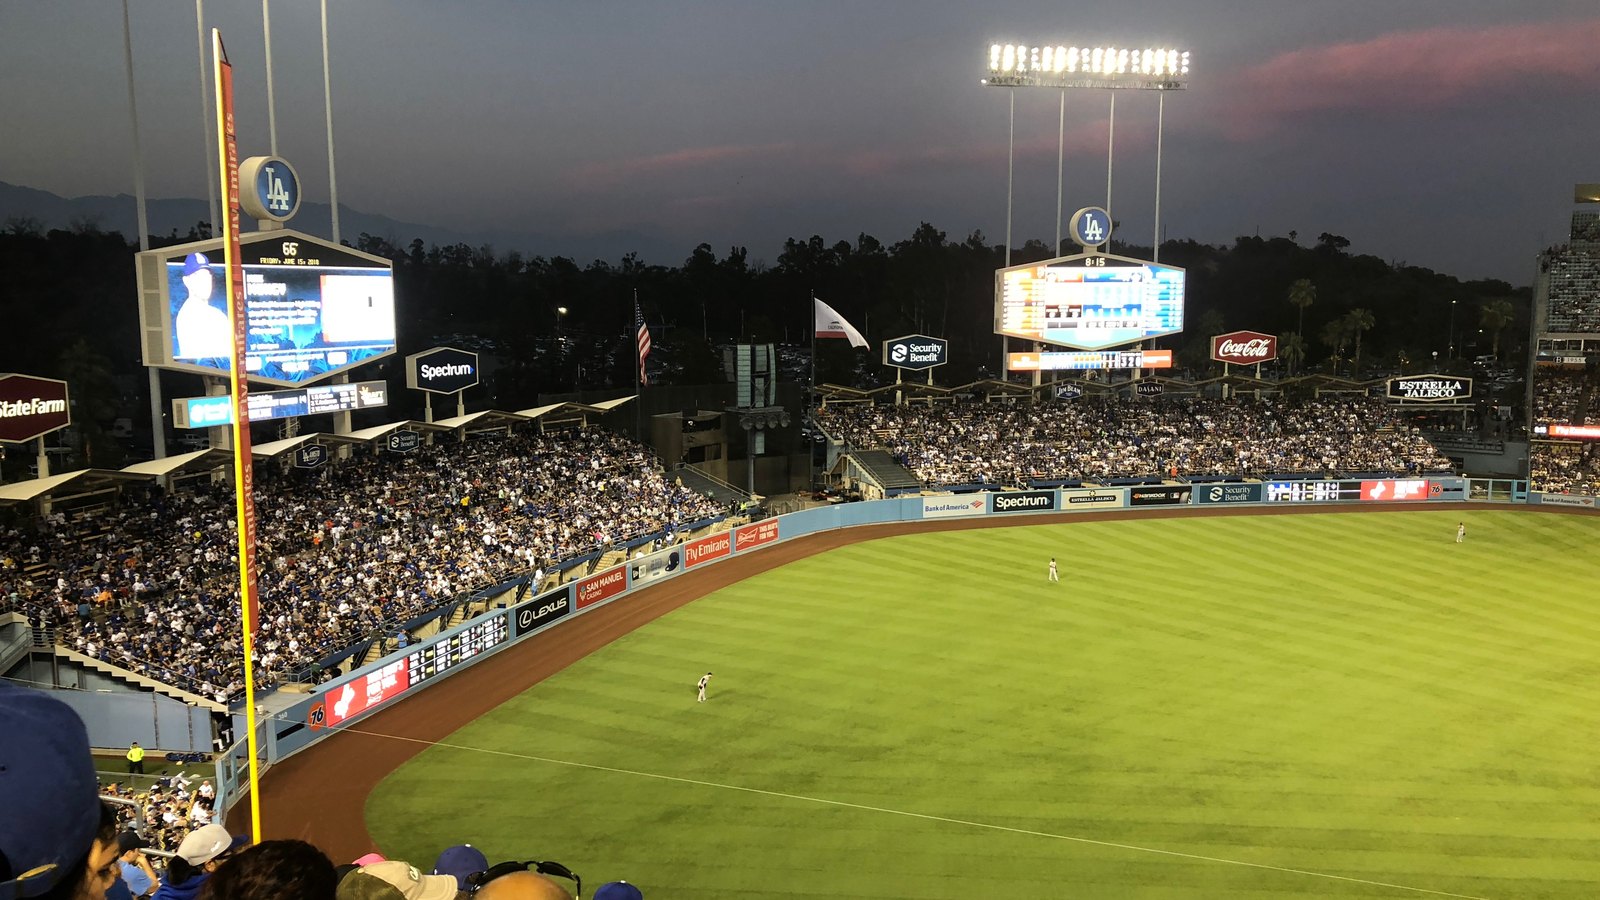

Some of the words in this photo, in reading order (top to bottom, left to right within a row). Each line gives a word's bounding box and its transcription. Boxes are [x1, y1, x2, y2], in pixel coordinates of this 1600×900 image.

[265, 167, 289, 211] LA
[1085, 213, 1103, 241] LA
[1085, 258, 1106, 267] 8:15
[909, 343, 942, 354] Security
[1218, 338, 1272, 357] Coca-Cola
[909, 353, 938, 362] Benefit
[421, 363, 471, 381] Spectrum
[1057, 385, 1067, 396] JIM
[1067, 385, 1081, 395] BEAM
[1398, 380, 1462, 390] ESTRELLA
[1404, 389, 1455, 398] JALISCO
[1224, 486, 1251, 495] Security
[1224, 493, 1249, 501] Benefit
[244, 463, 256, 549] Emirates
[946, 503, 969, 512] America
[996, 495, 1048, 510] Spectrum
[685, 547, 698, 561] Fly
[698, 537, 730, 556] Emirates
[586, 582, 599, 593] SAN
[599, 571, 624, 588] MANUEL
[586, 589, 602, 600] CASINO
[532, 597, 567, 620] LEXUS
[311, 705, 324, 727] 76
